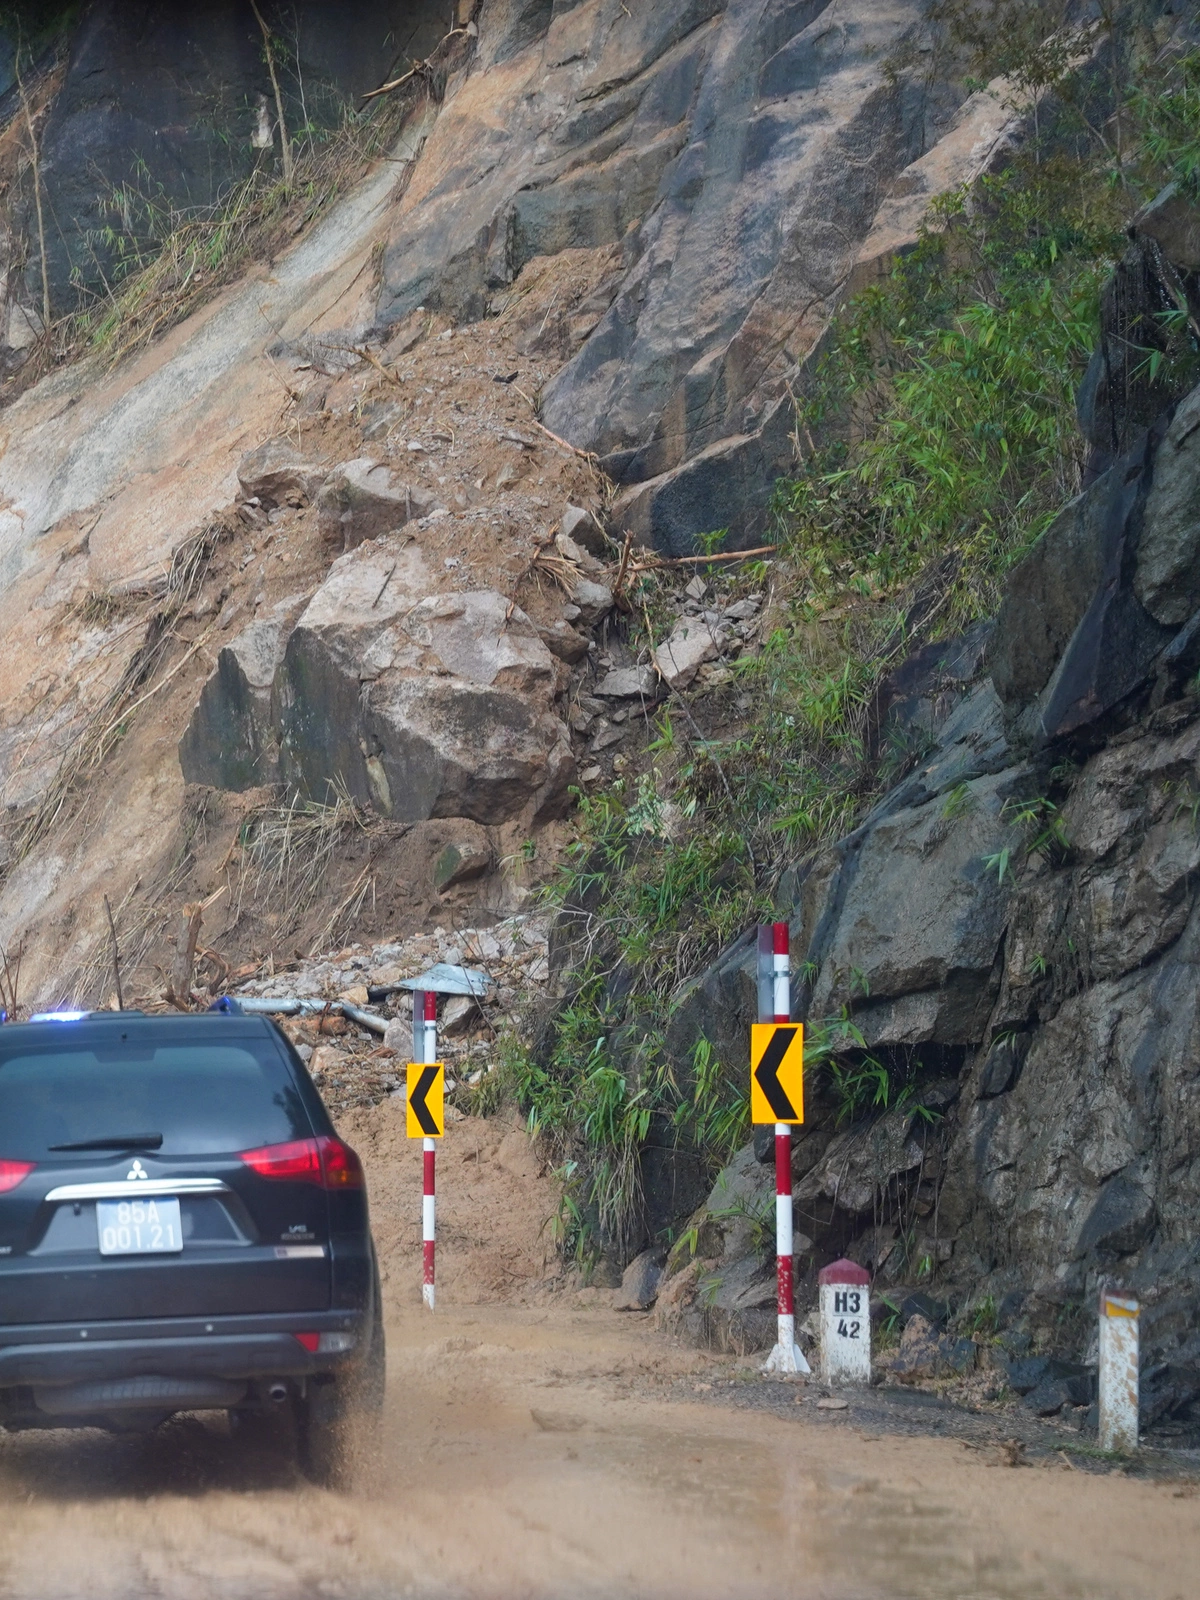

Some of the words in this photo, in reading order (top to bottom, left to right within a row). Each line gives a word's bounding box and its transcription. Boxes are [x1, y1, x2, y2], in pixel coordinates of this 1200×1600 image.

[117, 1200, 160, 1225] 85A
[102, 1224, 175, 1251] 001.21
[834, 1291, 861, 1314] H3
[837, 1319, 861, 1339] 42
